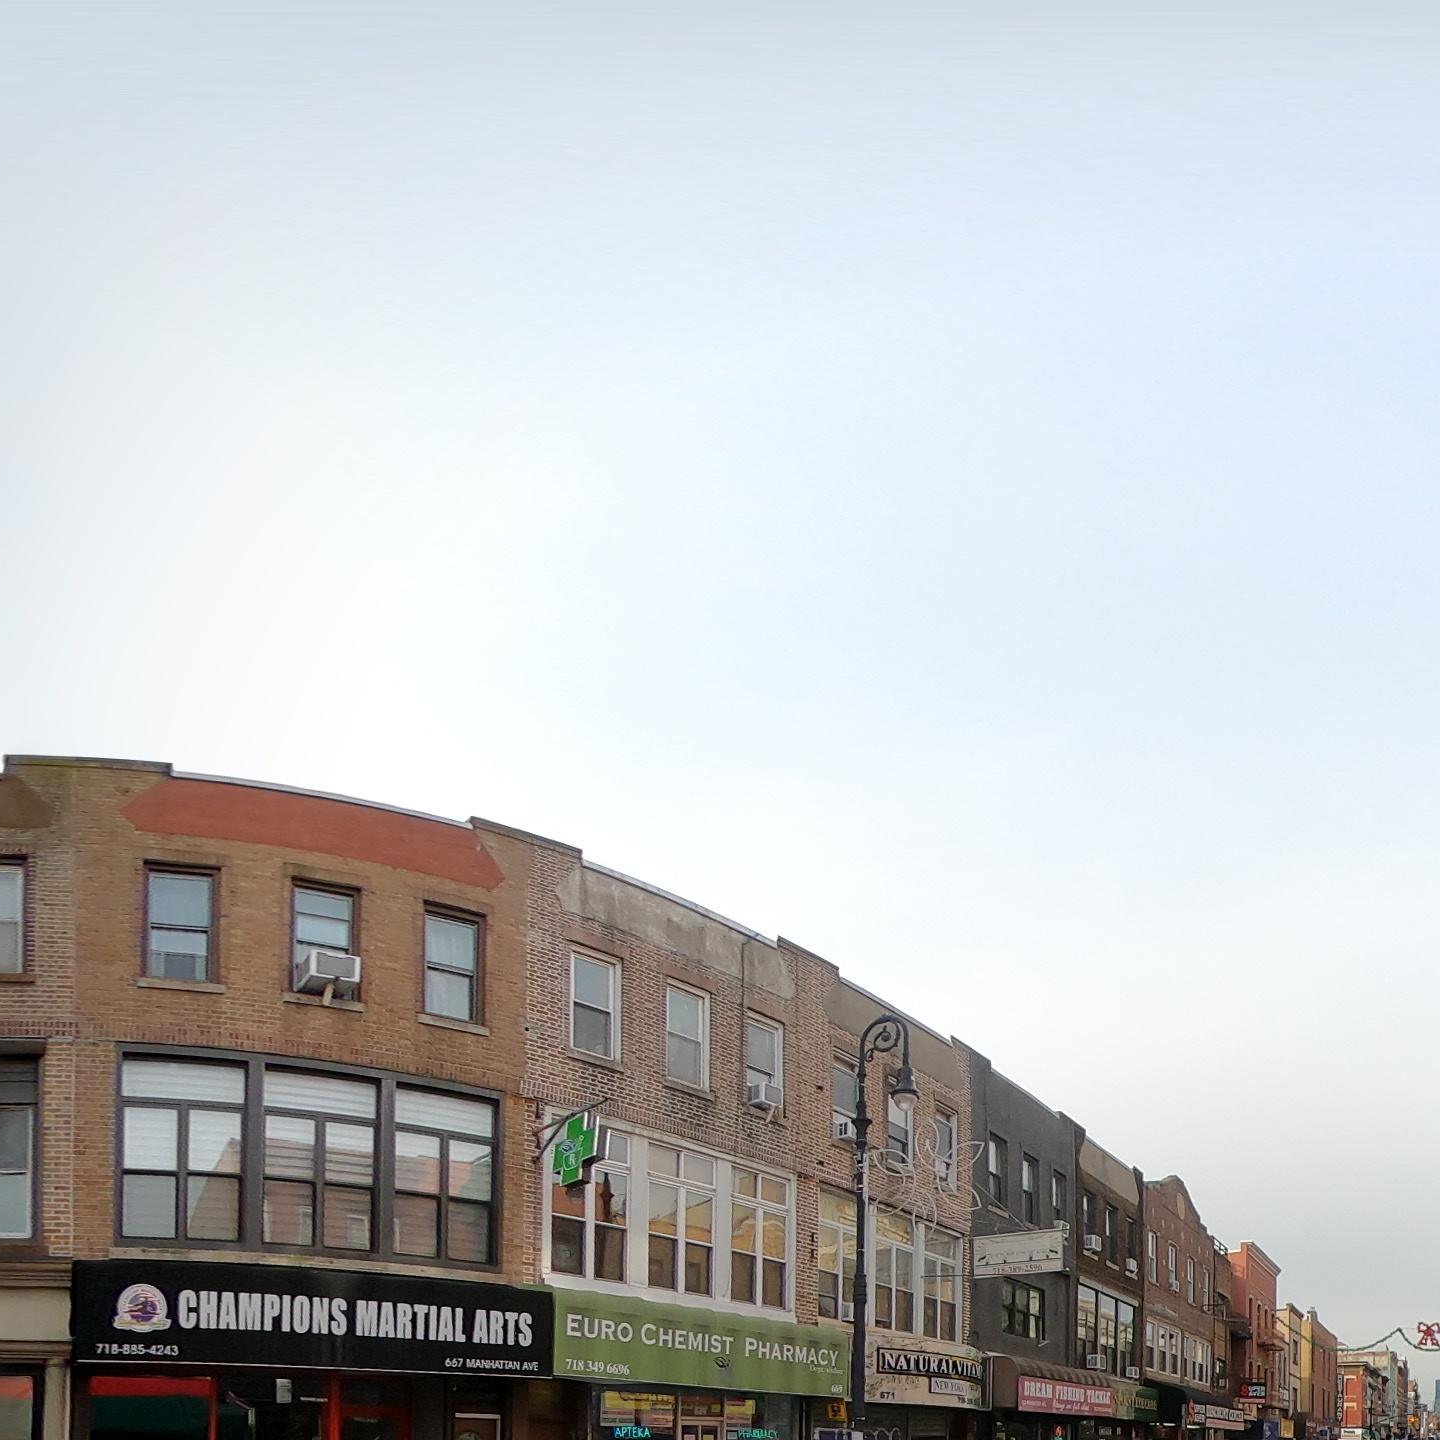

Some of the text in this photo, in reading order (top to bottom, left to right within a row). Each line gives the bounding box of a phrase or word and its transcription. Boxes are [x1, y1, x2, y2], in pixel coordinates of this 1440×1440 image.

[177, 1289, 348, 1336] CHAMPIONS
[355, 1299, 467, 1343] MARTIAL
[471, 1308, 533, 1347] ARTS
[95, 1343, 180, 1357] 718-885-4243
[565, 1313, 840, 1367] EURO CHEMIST PHARMACY
[444, 1357, 539, 1372] 667 MANHATTAN AVE
[565, 1358, 630, 1375] 718 349 6696
[881, 1352, 957, 1376] NATURAL
[1023, 1380, 1053, 1399] DREAM
[1055, 1385, 1085, 1403] FISHING
[613, 1426, 652, 1439] APTEKA
